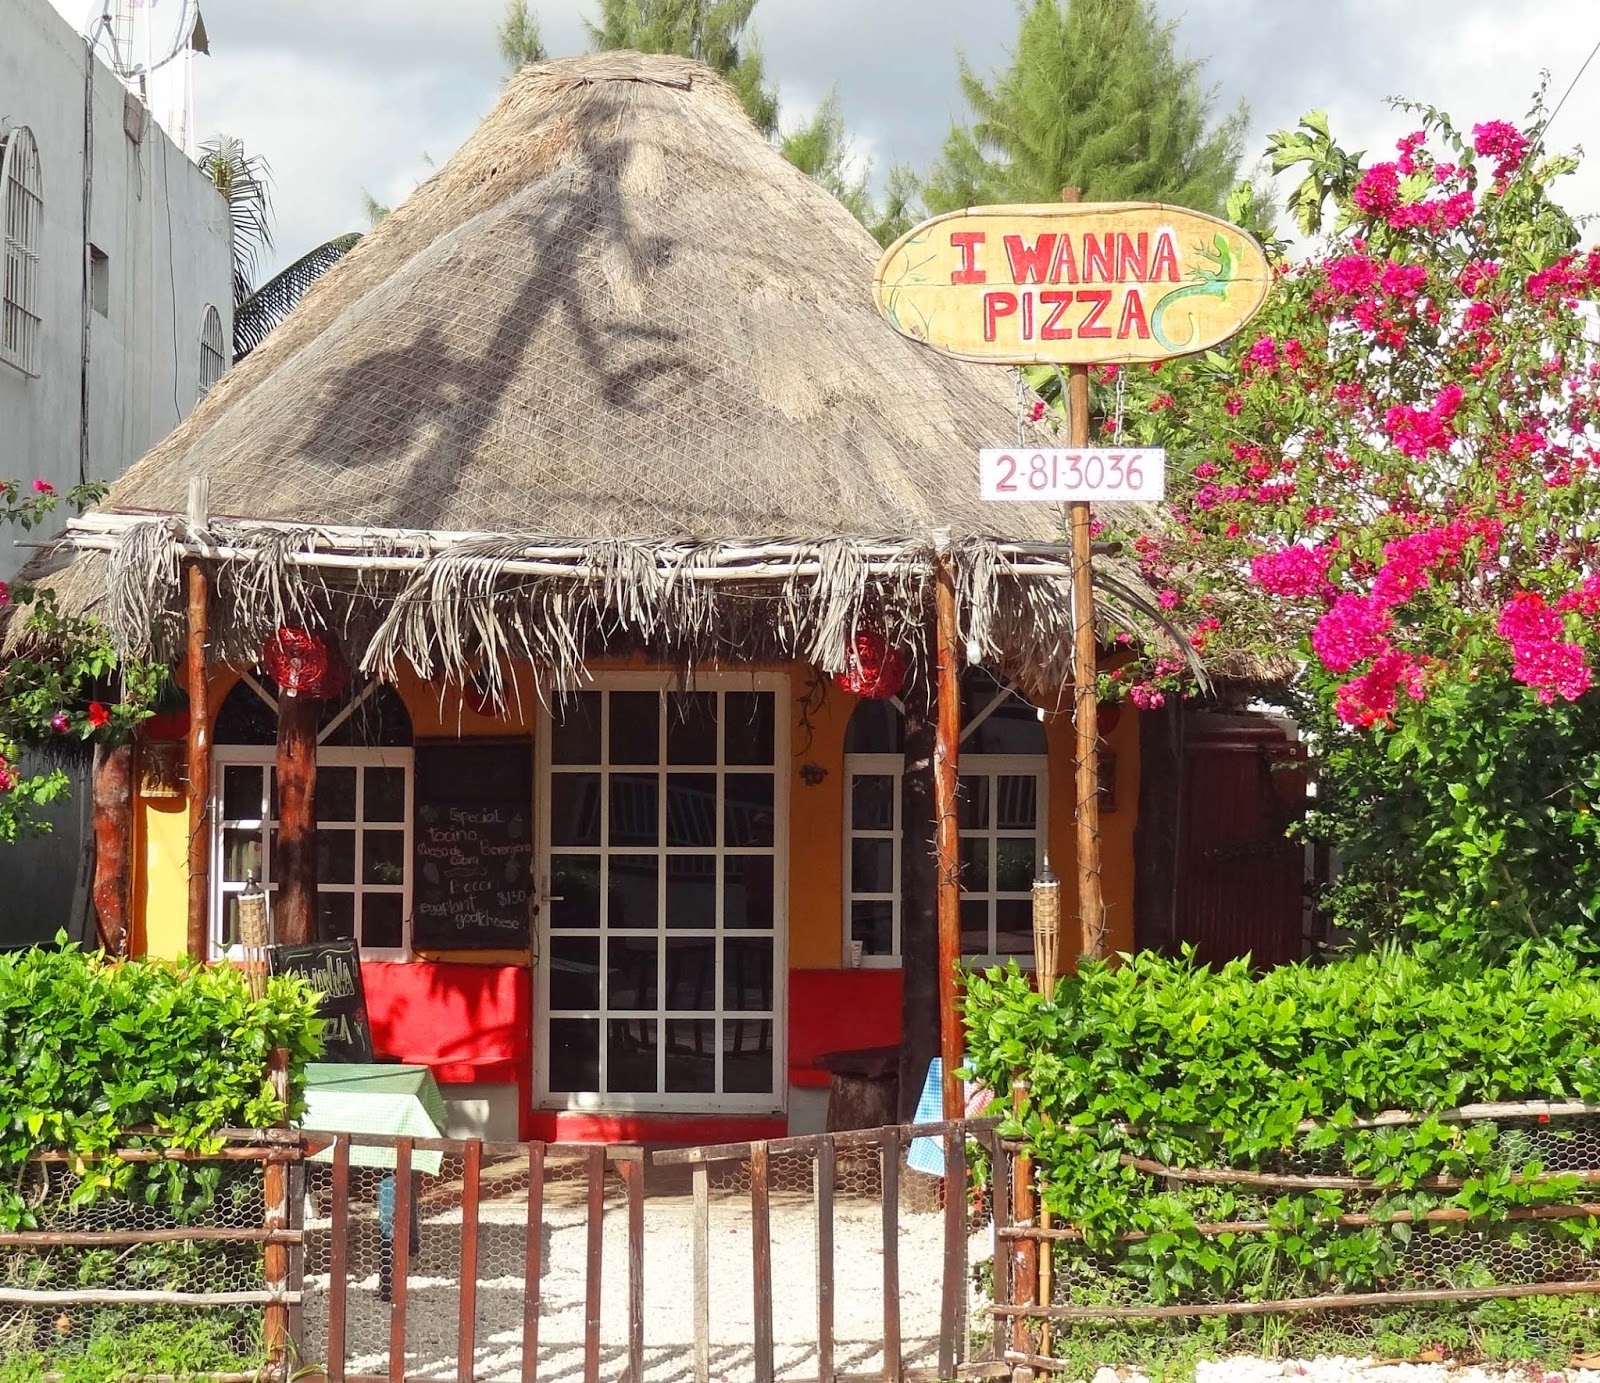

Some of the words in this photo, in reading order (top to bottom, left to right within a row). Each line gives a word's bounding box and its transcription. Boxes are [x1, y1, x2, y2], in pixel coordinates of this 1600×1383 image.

[950, 231, 986, 285] I
[1003, 231, 1181, 285] WANNA
[983, 289, 1151, 342] PIZZA
